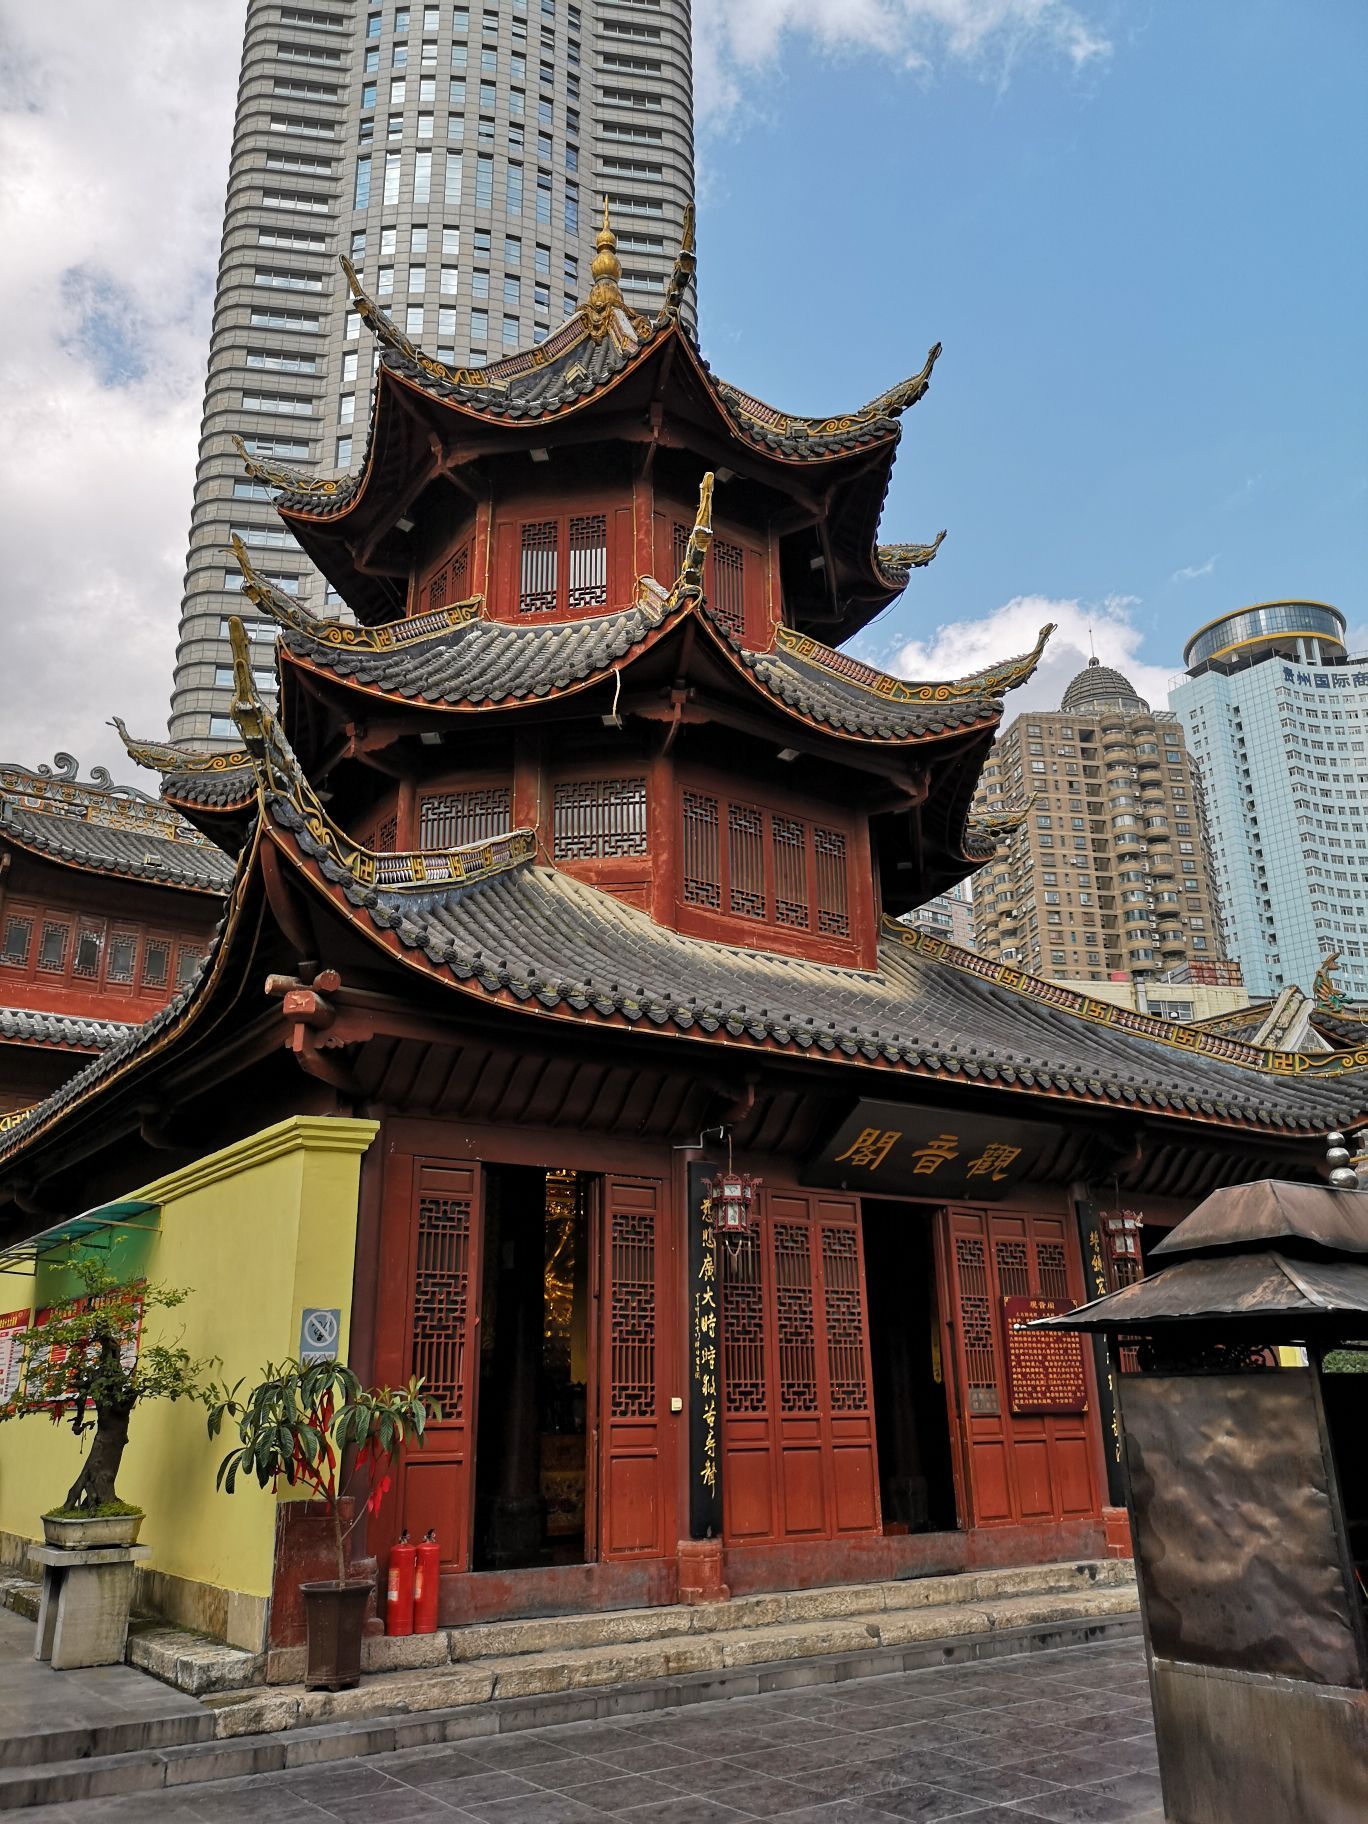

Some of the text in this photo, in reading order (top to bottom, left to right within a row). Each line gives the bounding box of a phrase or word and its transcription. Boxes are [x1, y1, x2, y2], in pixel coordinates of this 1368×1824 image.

[1283, 666, 1368, 689] 贵州国际商
